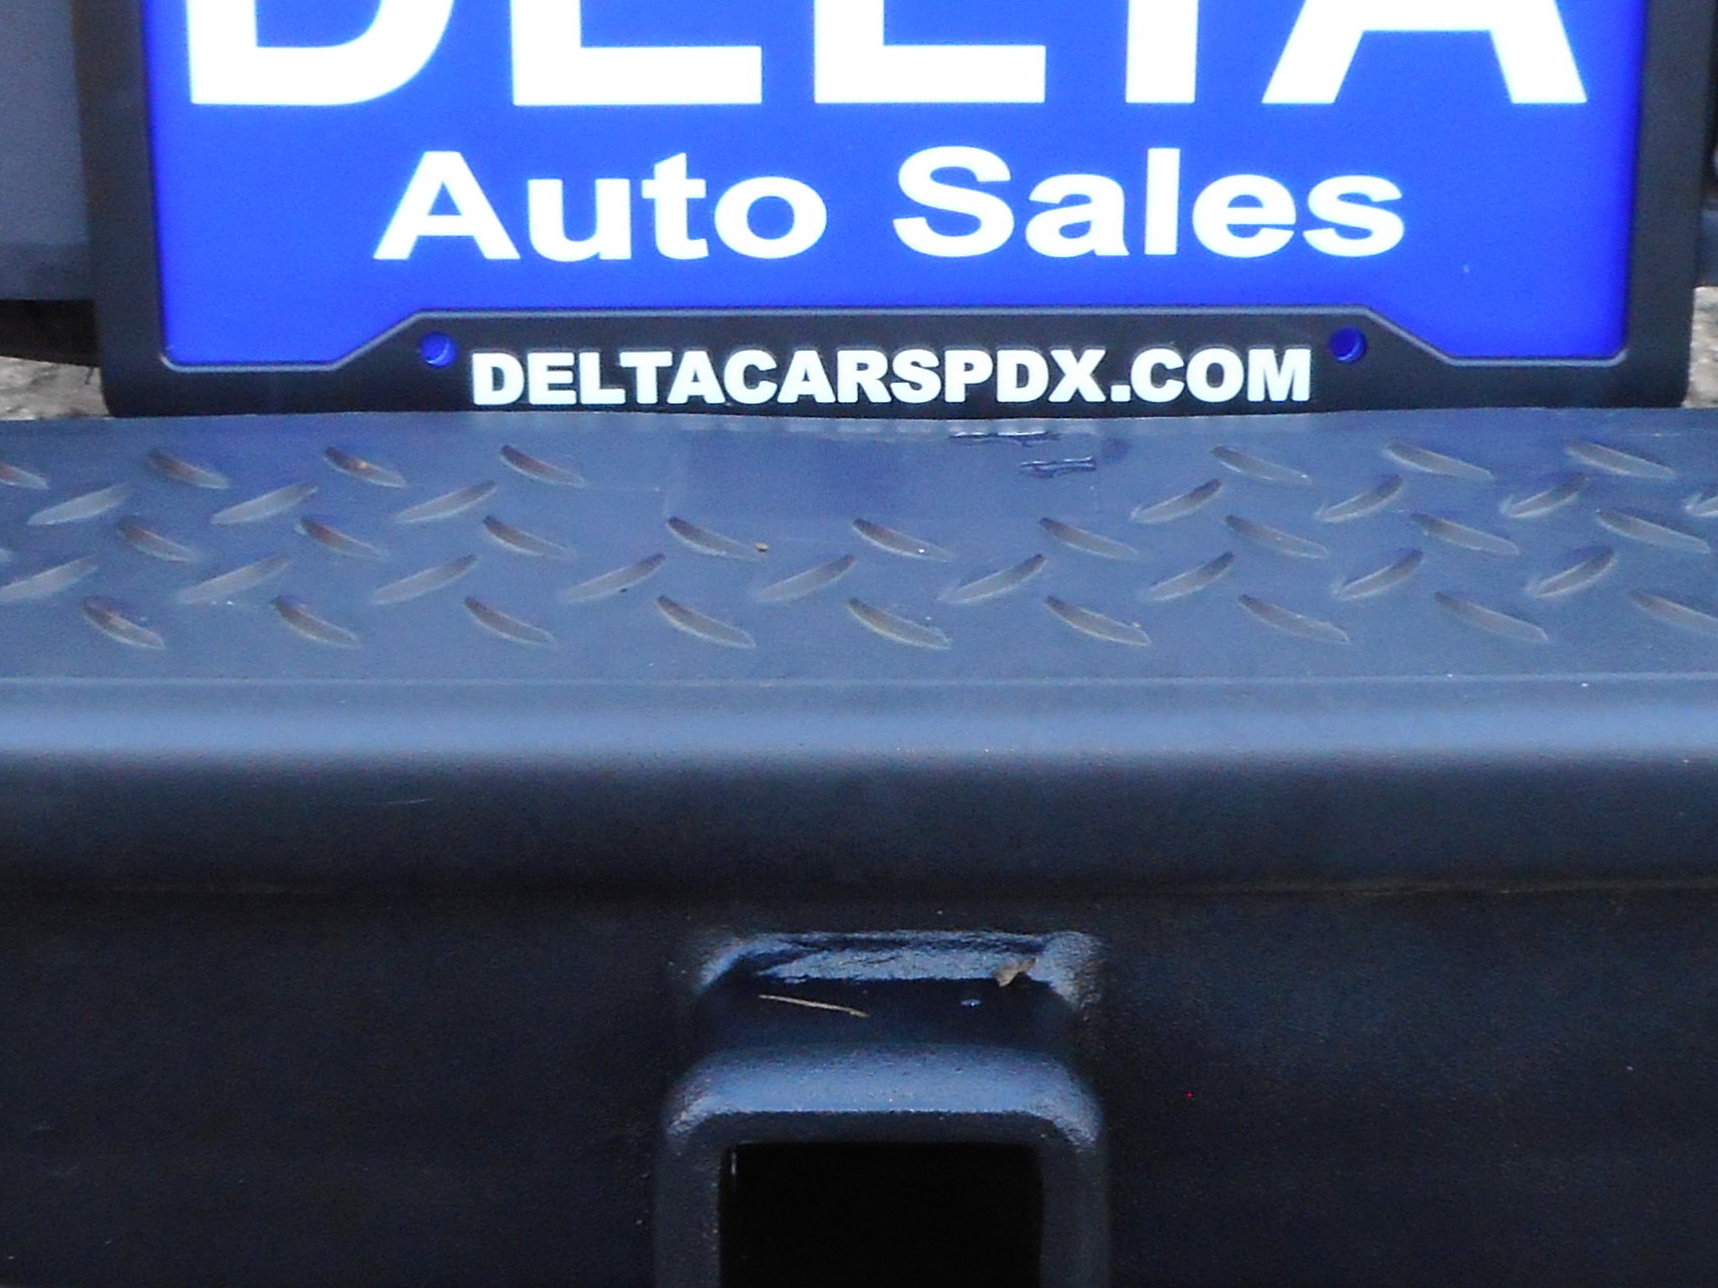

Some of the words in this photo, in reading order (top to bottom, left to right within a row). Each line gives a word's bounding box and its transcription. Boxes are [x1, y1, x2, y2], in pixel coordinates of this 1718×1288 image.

[373, 150, 828, 263] Auto
[892, 145, 1405, 258] Sales
[471, 346, 1313, 407] DELTACARSPDX.COM
